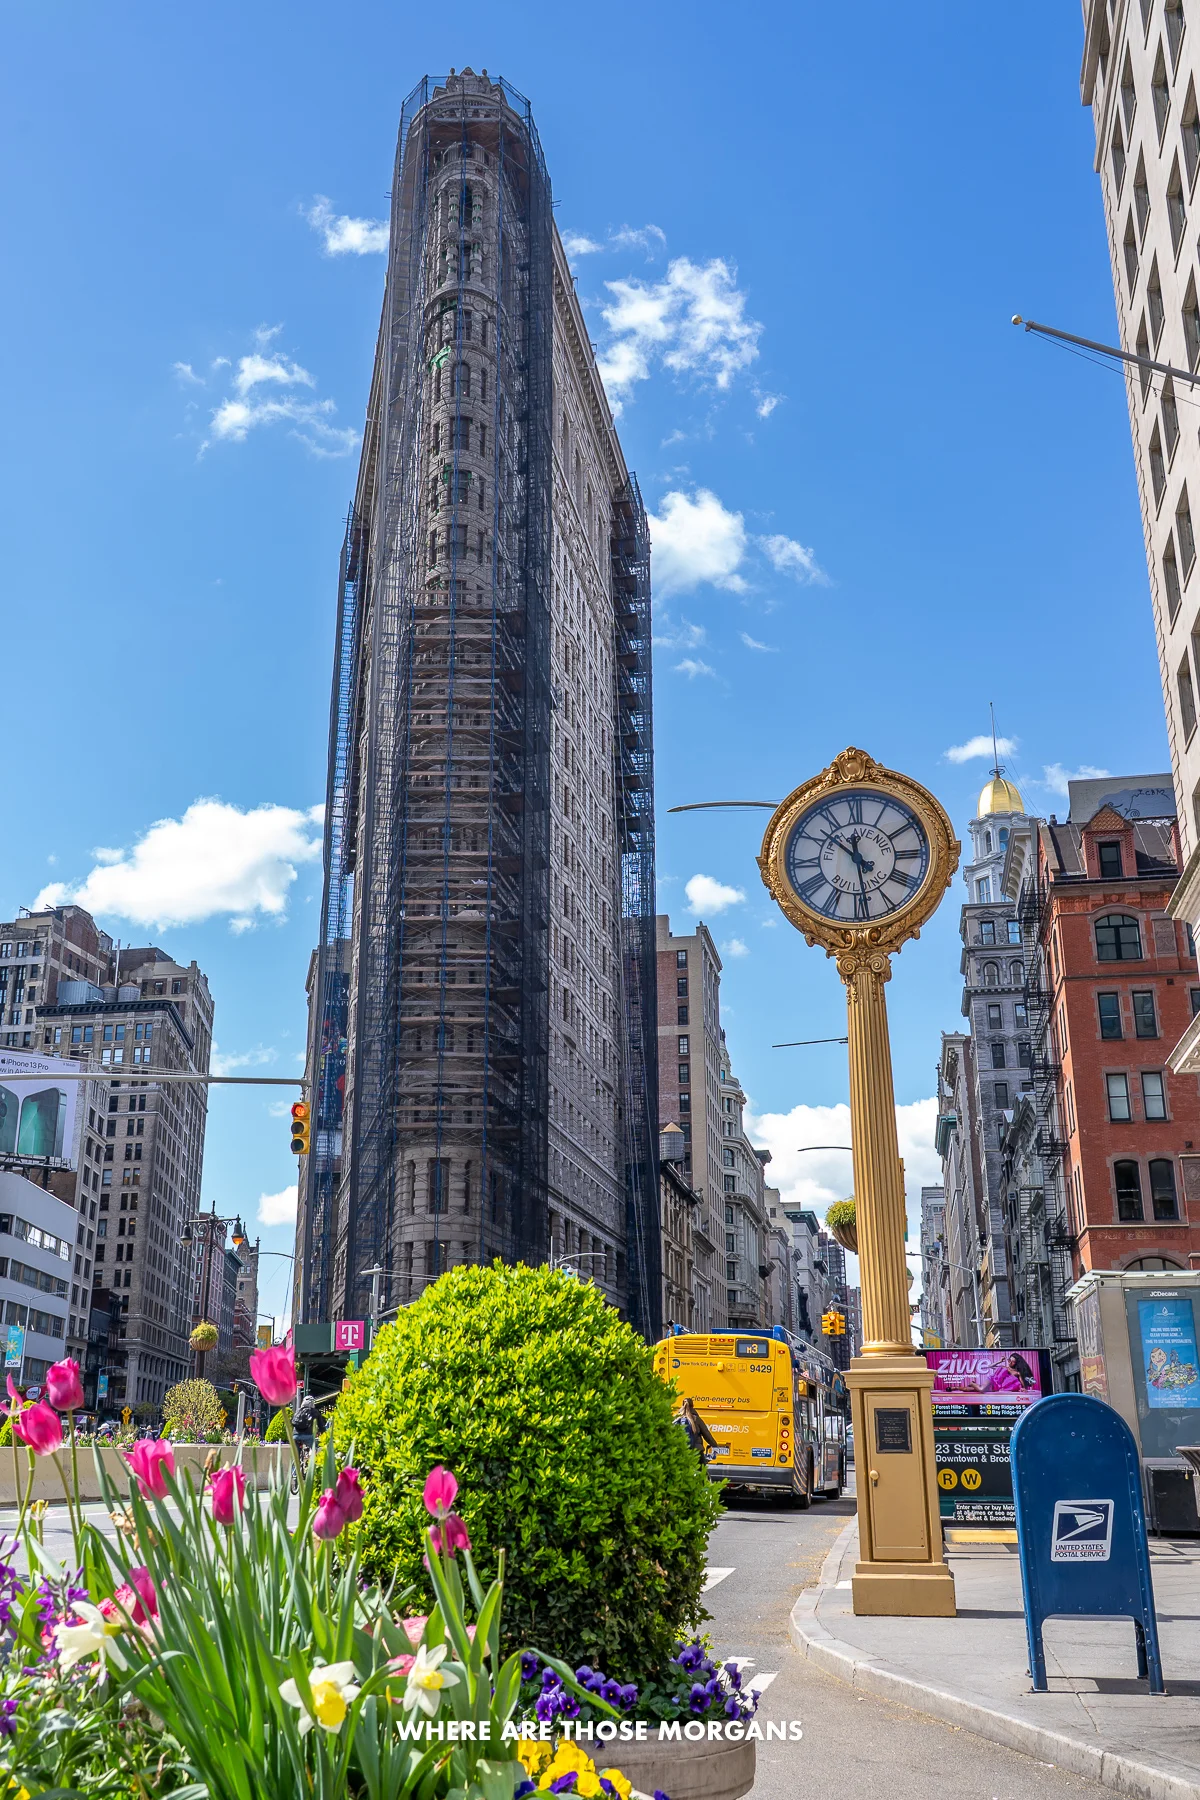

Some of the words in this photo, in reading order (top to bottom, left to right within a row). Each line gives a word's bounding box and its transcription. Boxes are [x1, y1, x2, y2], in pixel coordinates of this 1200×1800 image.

[852, 828, 891, 856] AVENUE
[6, 1058, 30, 1068] iPhone
[30, 1061, 37, 1069] 13
[37, 1062, 49, 1071] Pro
[341, 1324, 359, 1346] T
[746, 1343, 758, 1354] M3
[749, 1364, 772, 1373] 9429
[691, 1395, 736, 1404] clean-energy
[935, 1443, 950, 1454] 23
[953, 1443, 989, 1454] Street
[992, 1443, 1011, 1454] Sta
[935, 1454, 979, 1463] Downtown
[980, 1454, 988, 1463] &
[991, 1504, 1001, 1512] buy
